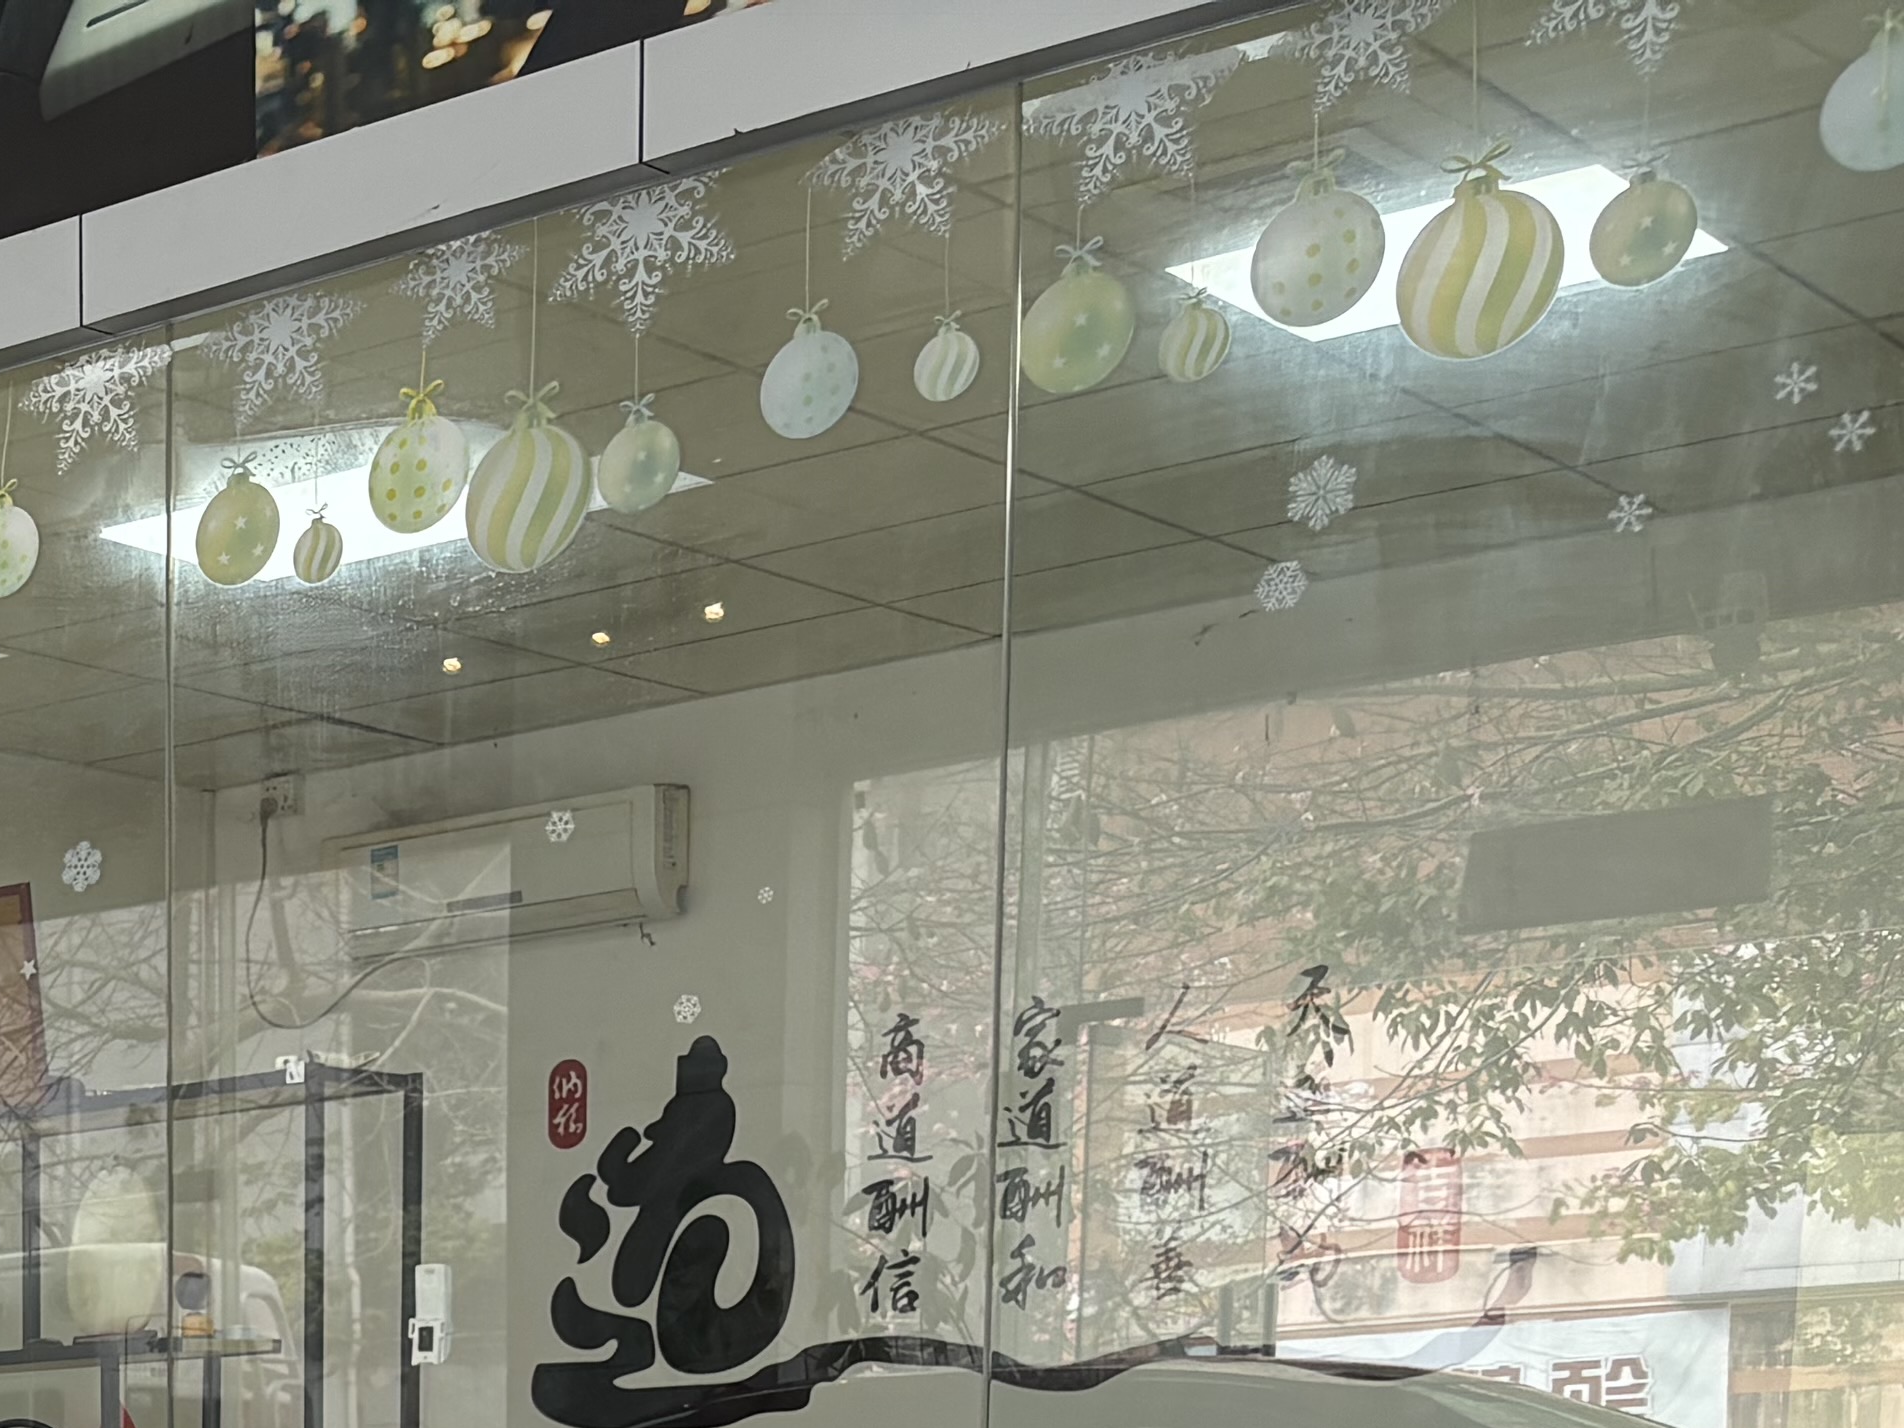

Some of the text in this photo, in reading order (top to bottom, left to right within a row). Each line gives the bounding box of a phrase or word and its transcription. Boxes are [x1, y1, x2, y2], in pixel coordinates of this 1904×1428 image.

[861, 1012, 933, 1315] 商道酬信
[996, 994, 1067, 1311] 家道酬和
